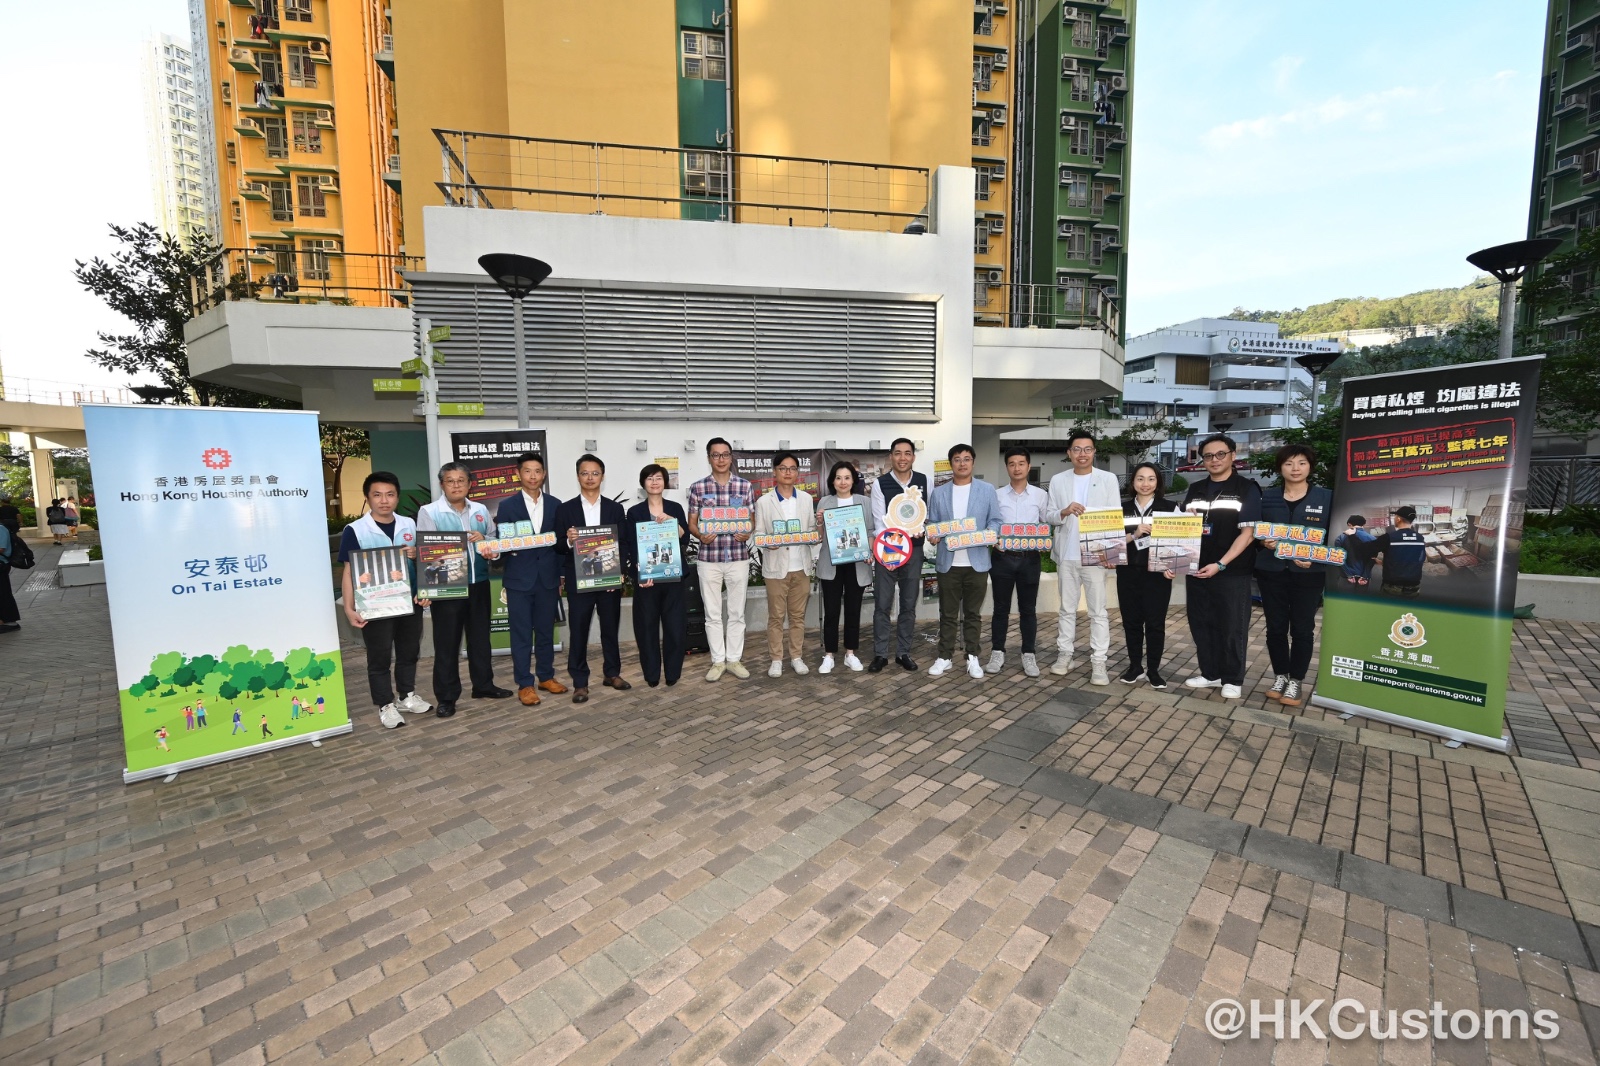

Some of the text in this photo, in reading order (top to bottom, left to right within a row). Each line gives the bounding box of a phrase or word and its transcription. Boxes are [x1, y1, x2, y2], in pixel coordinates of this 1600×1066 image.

[1353, 382, 1521, 410] 買賣私煙 均屬違法
[1437, 404, 1478, 413] cigarettes
[1491, 400, 1520, 408] illegal
[459, 442, 540, 453] 買賣私煙 均屬違法
[737, 458, 772, 468] 買賣私煙
[1403, 458, 1428, 466] penalty
[1452, 456, 1505, 468] imprisonment
[154, 474, 279, 487] 香港房屋委員會
[121, 488, 309, 502] Hong Kong Housing Authority
[700, 521, 752, 532] 1828080
[1256, 523, 1324, 543] 買賣私煙
[1278, 543, 1345, 564] 均屬違法
[184, 554, 268, 578] 安泰邨
[172, 577, 283, 595] On Tai Estate
[1380, 647, 1433, 664] 香港海關
[1364, 674, 1483, 703] crimereport@customs.gov.hk
